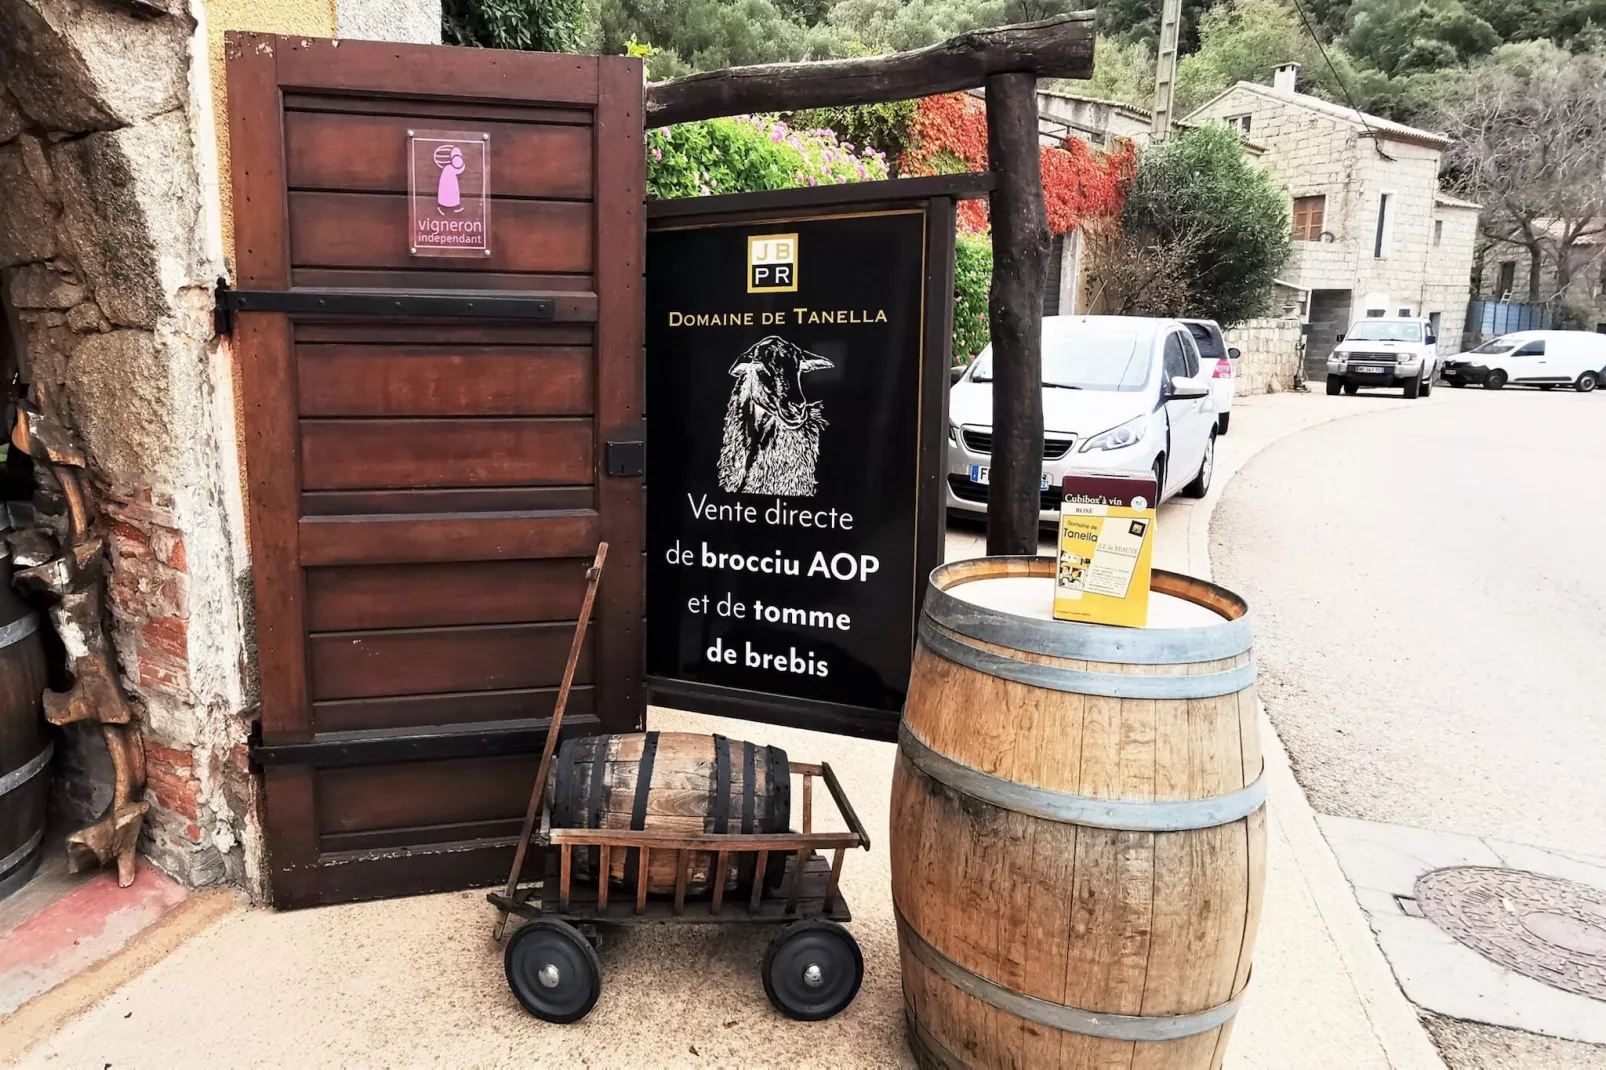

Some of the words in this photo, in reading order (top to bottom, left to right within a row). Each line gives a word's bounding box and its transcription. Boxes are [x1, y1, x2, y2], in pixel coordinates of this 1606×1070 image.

[418, 218, 482, 235] vigneron
[669, 311, 754, 327] DOMAINE
[762, 312, 786, 326] DE
[793, 308, 888, 325] TANELLA
[687, 492, 757, 523] Vente
[765, 498, 854, 530] directe
[1109, 497, 1122, 506] vin
[1067, 520, 1090, 529] Domaine
[1064, 528, 1098, 542] Tanella
[666, 539, 694, 566] de
[701, 541, 800, 576] brocciu
[807, 550, 880, 582] AOP
[687, 594, 710, 614] et
[716, 591, 746, 619] de
[753, 600, 851, 631] tomme
[706, 637, 737, 665] de
[745, 641, 829, 677] brebis
